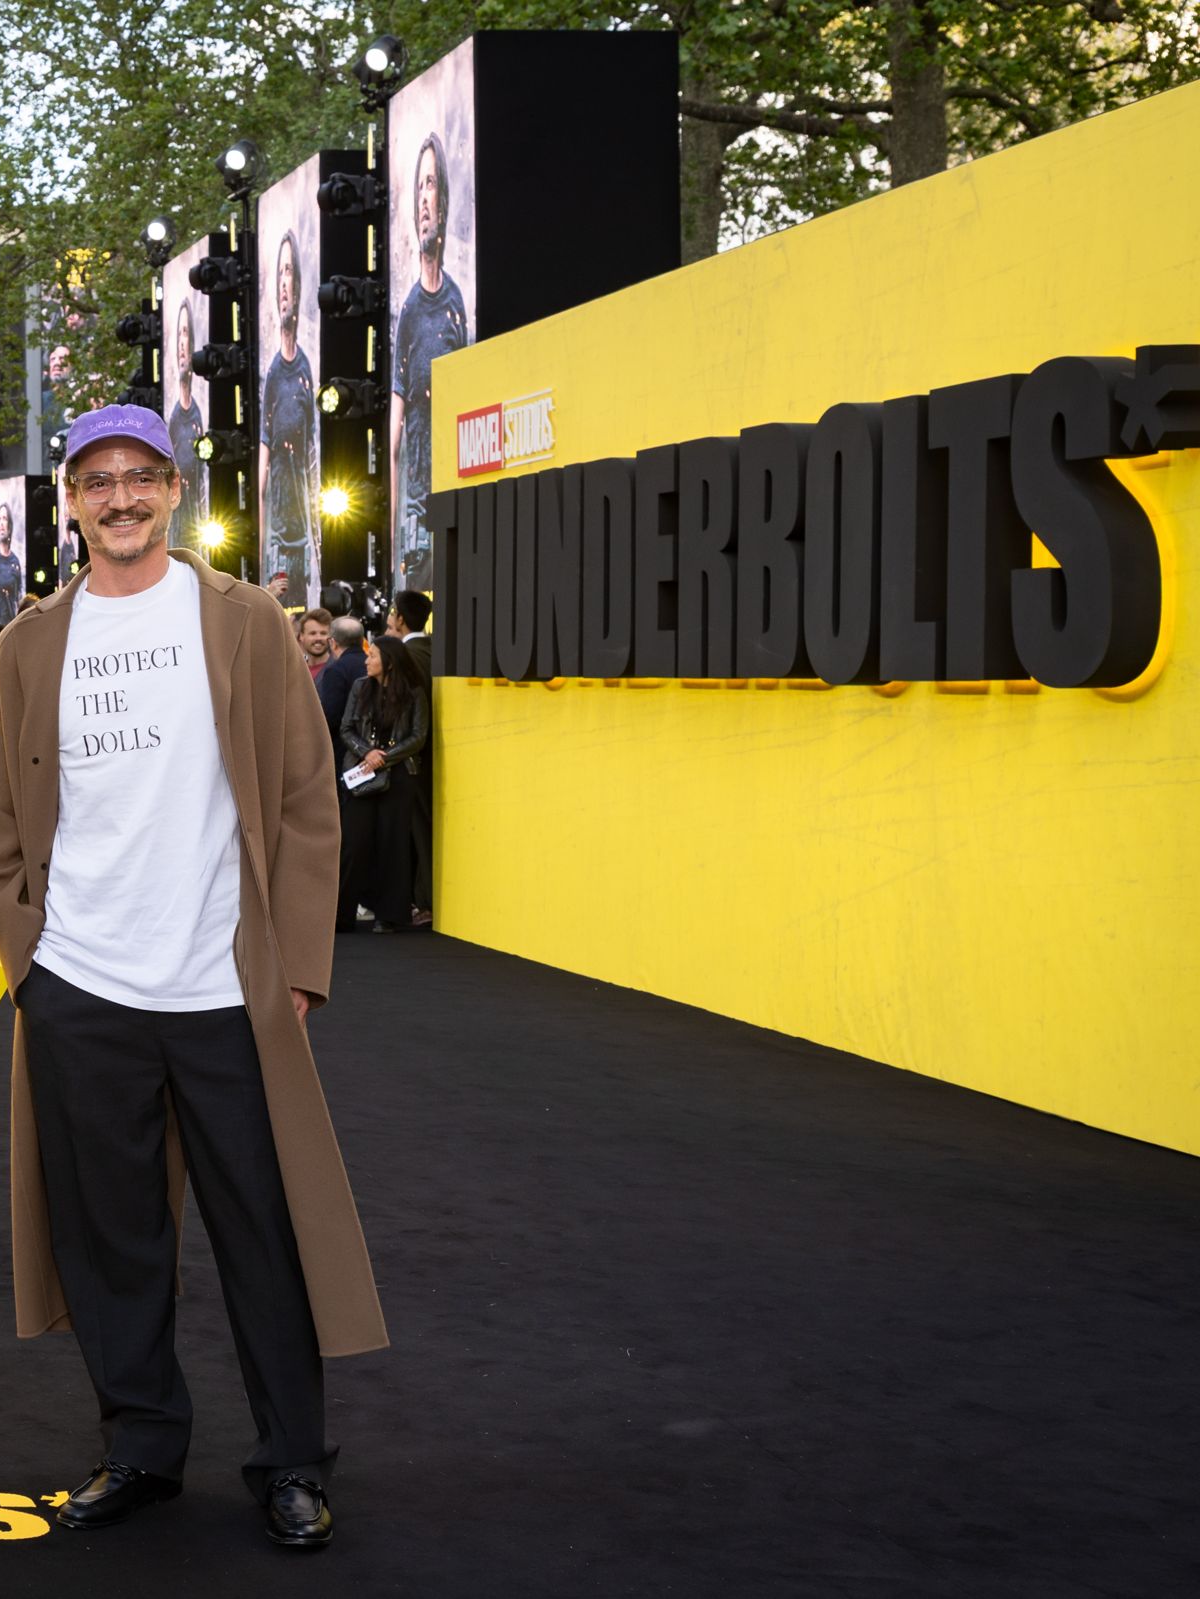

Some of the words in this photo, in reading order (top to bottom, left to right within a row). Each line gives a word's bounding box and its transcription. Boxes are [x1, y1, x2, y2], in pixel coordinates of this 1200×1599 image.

[458, 411, 502, 471] MARVEL
[503, 396, 554, 459] STUDIOS
[73, 645, 183, 680] PROTECT
[76, 689, 128, 717] THE
[82, 725, 161, 758] DOLLS
